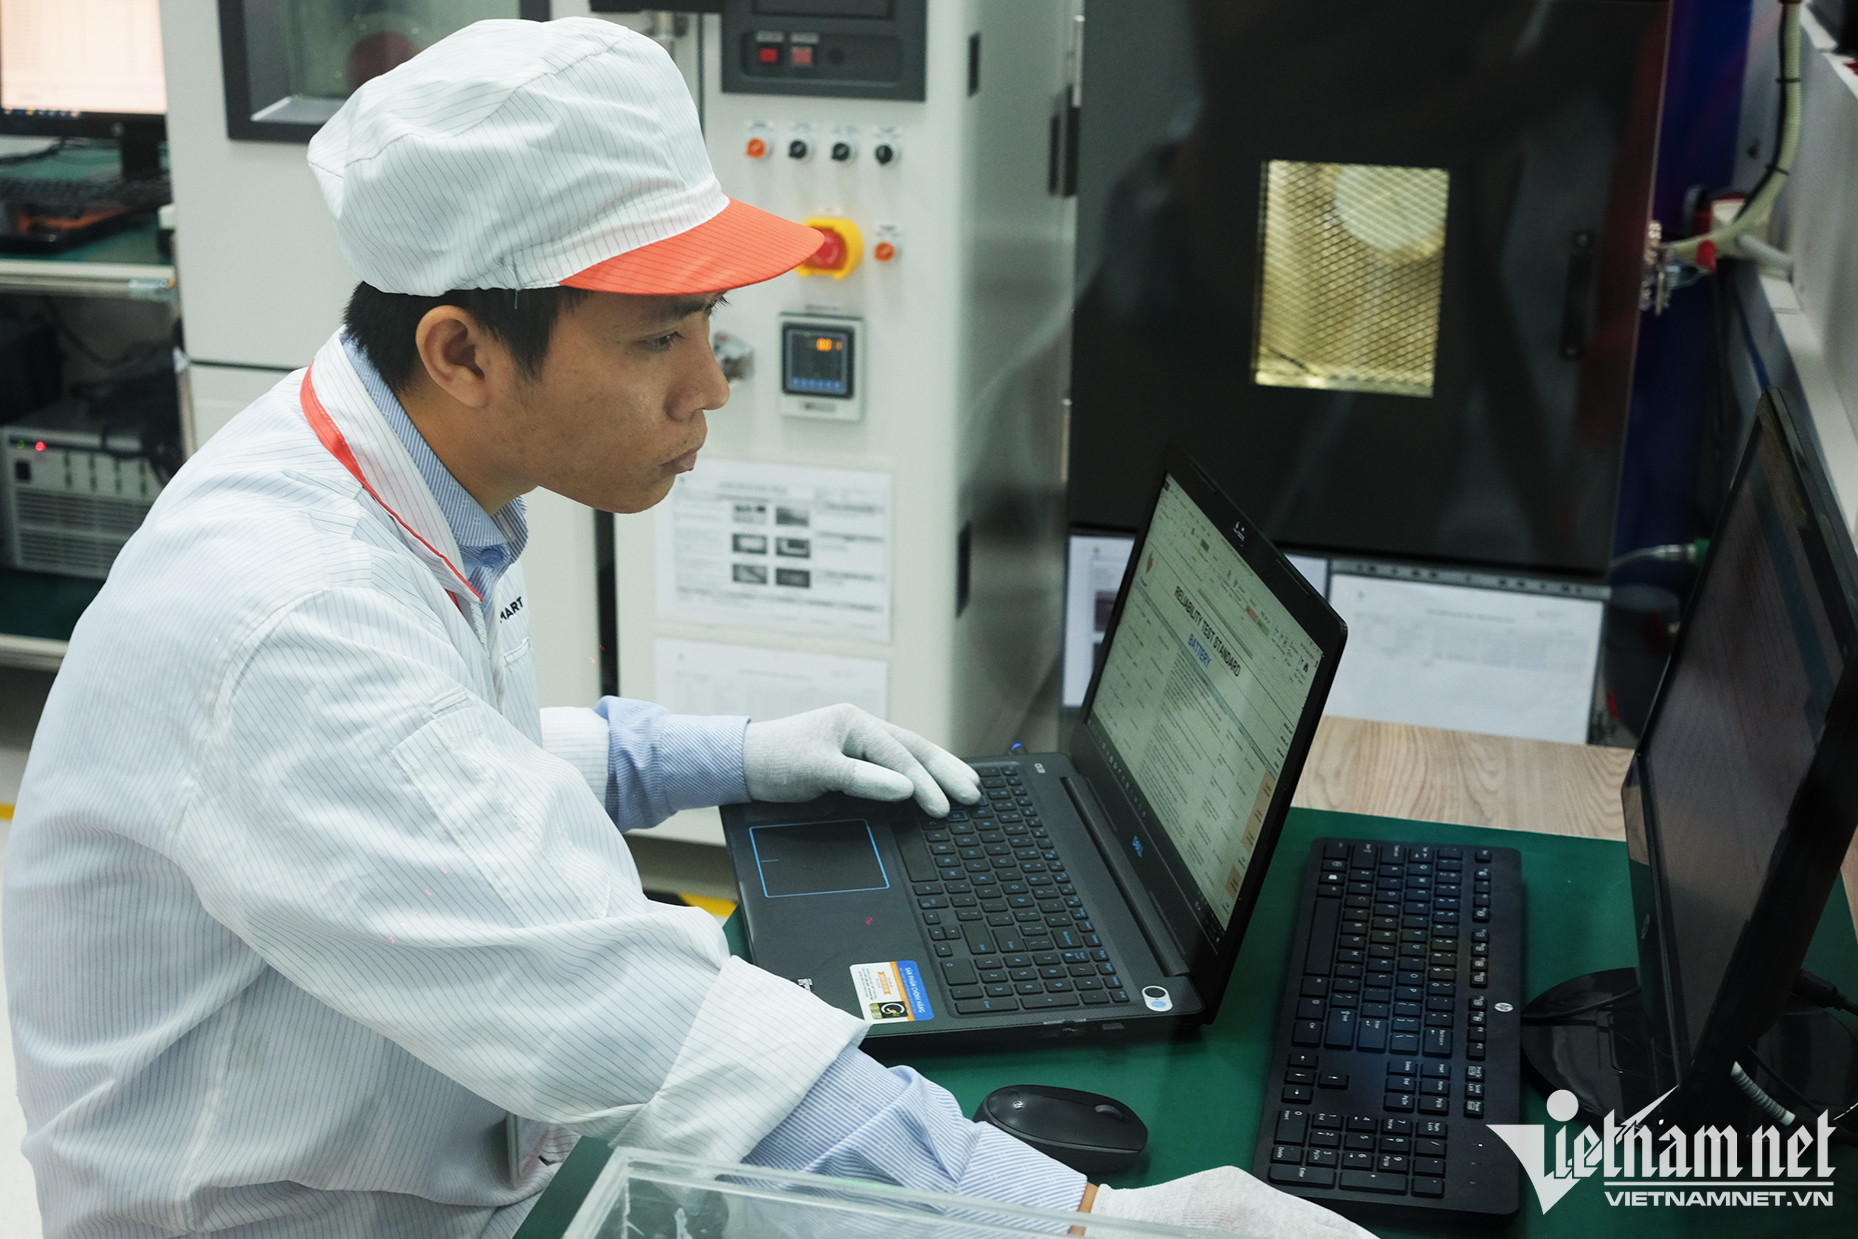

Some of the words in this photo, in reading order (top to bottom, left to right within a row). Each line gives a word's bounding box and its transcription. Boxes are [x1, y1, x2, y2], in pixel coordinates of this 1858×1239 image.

[1174, 586, 1202, 626] RELIABILITY
[1201, 620, 1215, 642] TEST
[1212, 636, 1241, 677] STANDARD
[1188, 634, 1211, 668] BATTERY
